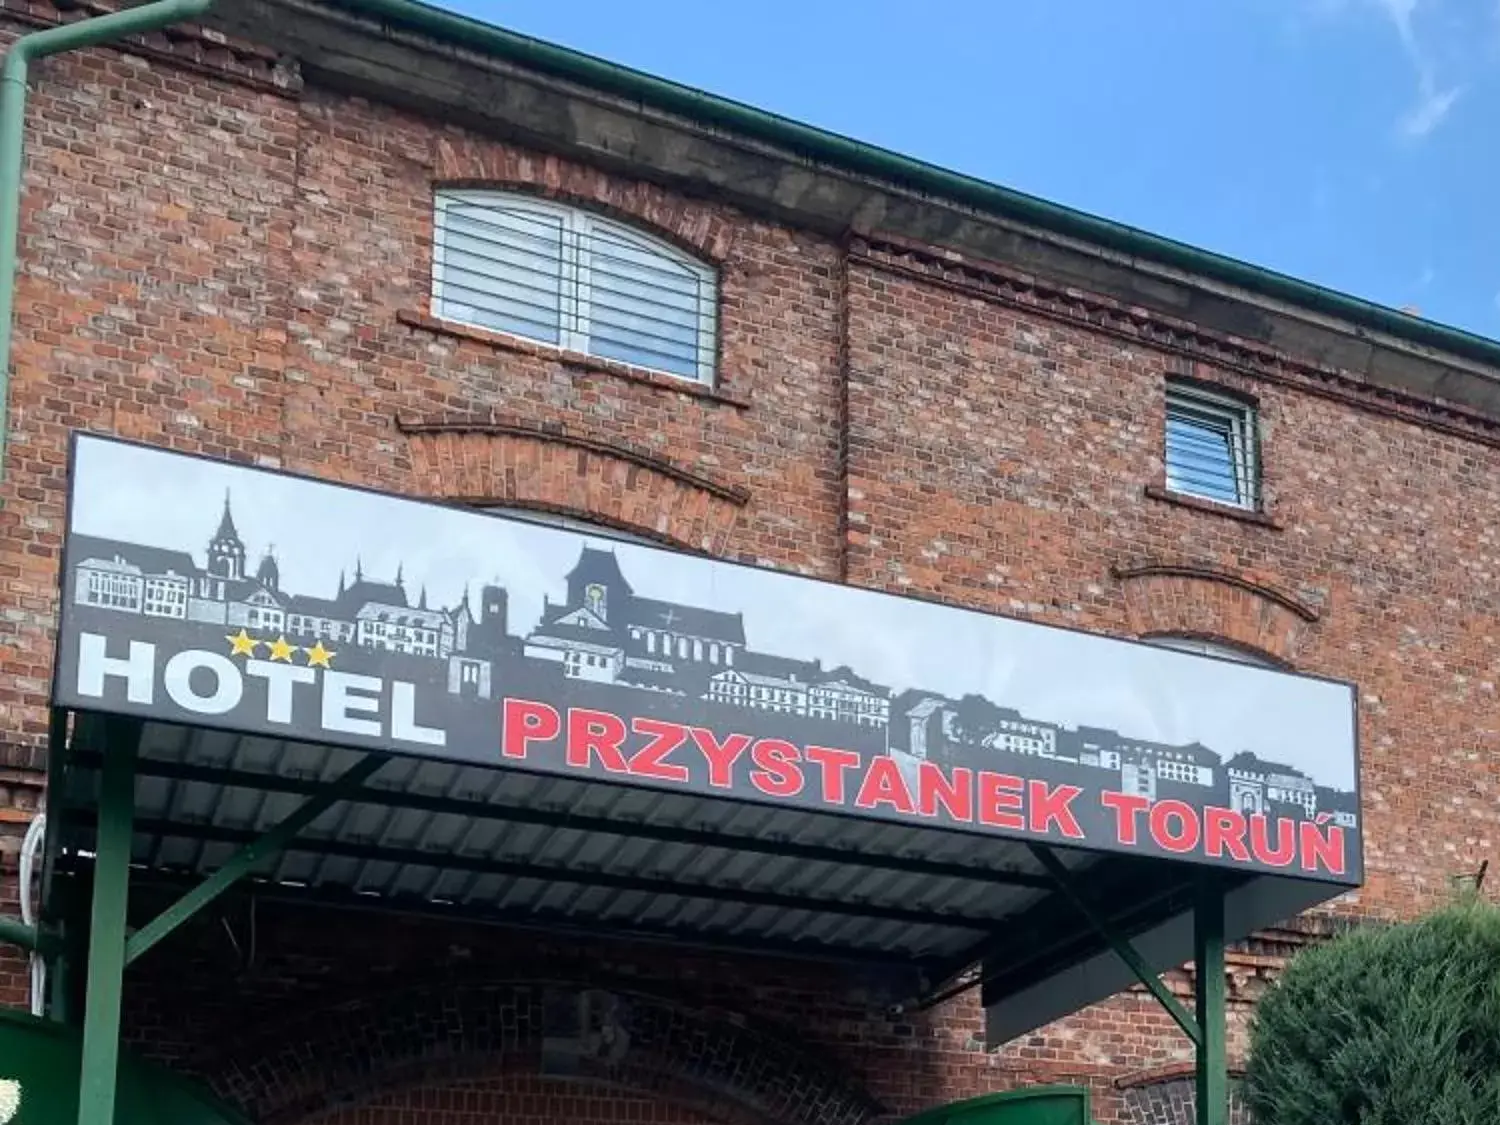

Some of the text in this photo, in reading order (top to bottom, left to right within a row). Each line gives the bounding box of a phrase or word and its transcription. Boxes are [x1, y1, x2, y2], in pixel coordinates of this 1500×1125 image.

[77, 632, 447, 746] HOTEL
[502, 697, 1345, 875] PRZYSTANEK TORUŃ
